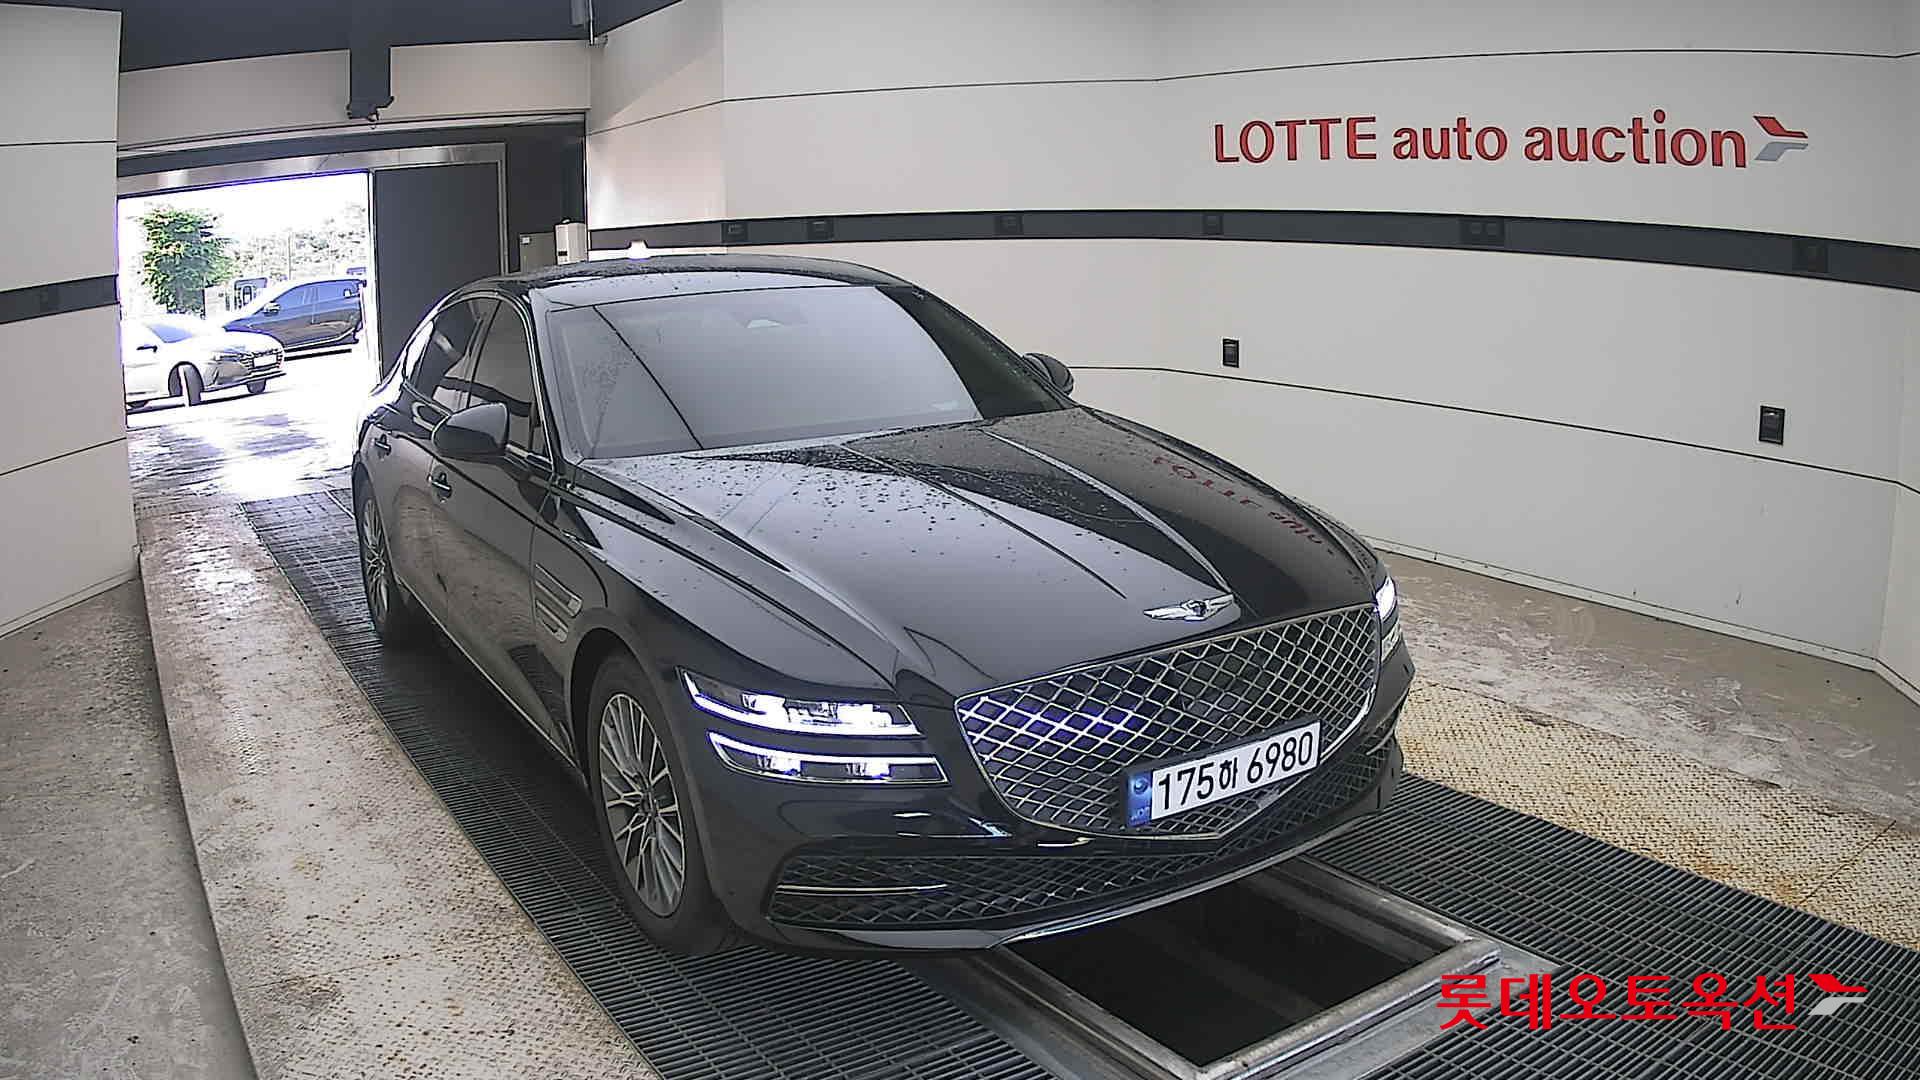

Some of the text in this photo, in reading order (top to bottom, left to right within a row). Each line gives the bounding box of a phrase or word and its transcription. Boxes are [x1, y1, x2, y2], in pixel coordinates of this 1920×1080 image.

[1214, 110, 1747, 168] LOTTE auto auction
[1158, 731, 1314, 810] 175하 6980
